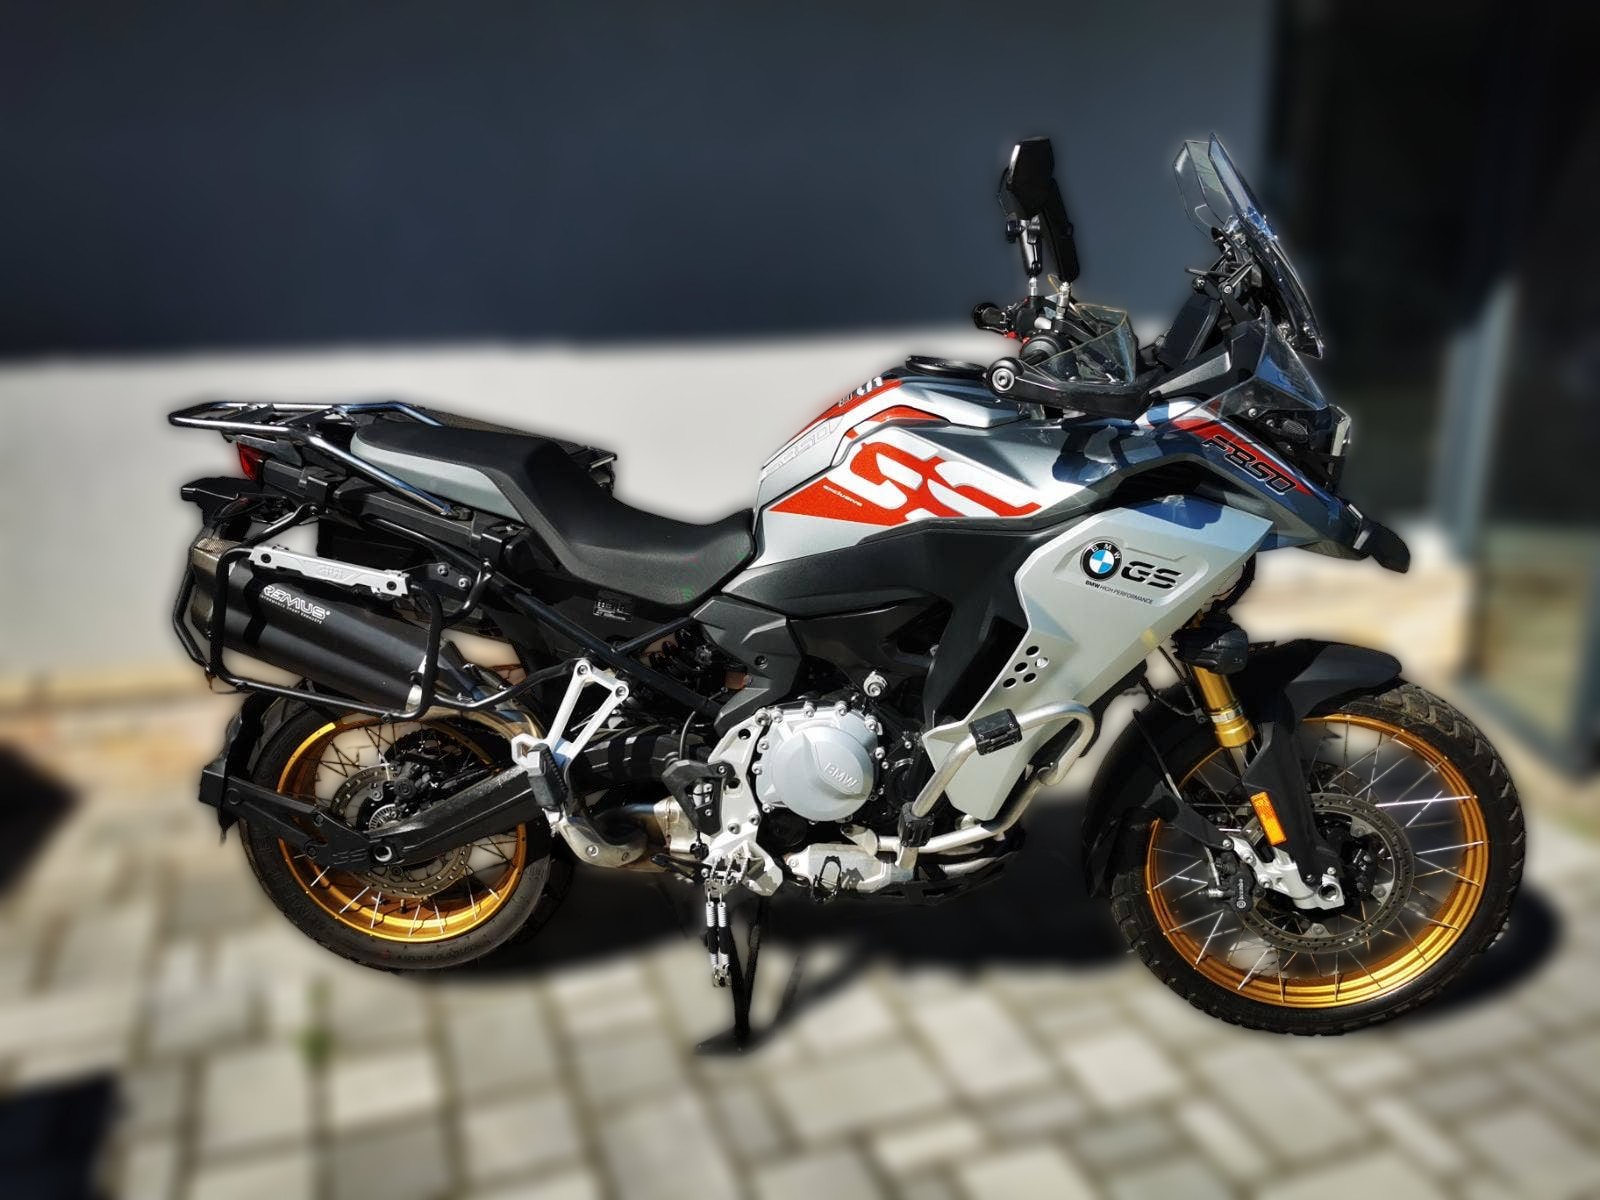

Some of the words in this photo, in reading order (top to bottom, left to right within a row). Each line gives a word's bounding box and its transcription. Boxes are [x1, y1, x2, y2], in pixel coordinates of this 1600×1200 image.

[1201, 434, 1297, 496] F850
[1091, 543, 1121, 560] BMW
[1121, 560, 1183, 590] GS
[263, 584, 326, 621] REMUS
[1085, 579, 1101, 590] BMW
[1099, 584, 1114, 594] HIGH
[1113, 588, 1154, 605] PERFORMANCE
[823, 761, 858, 788] BMW
